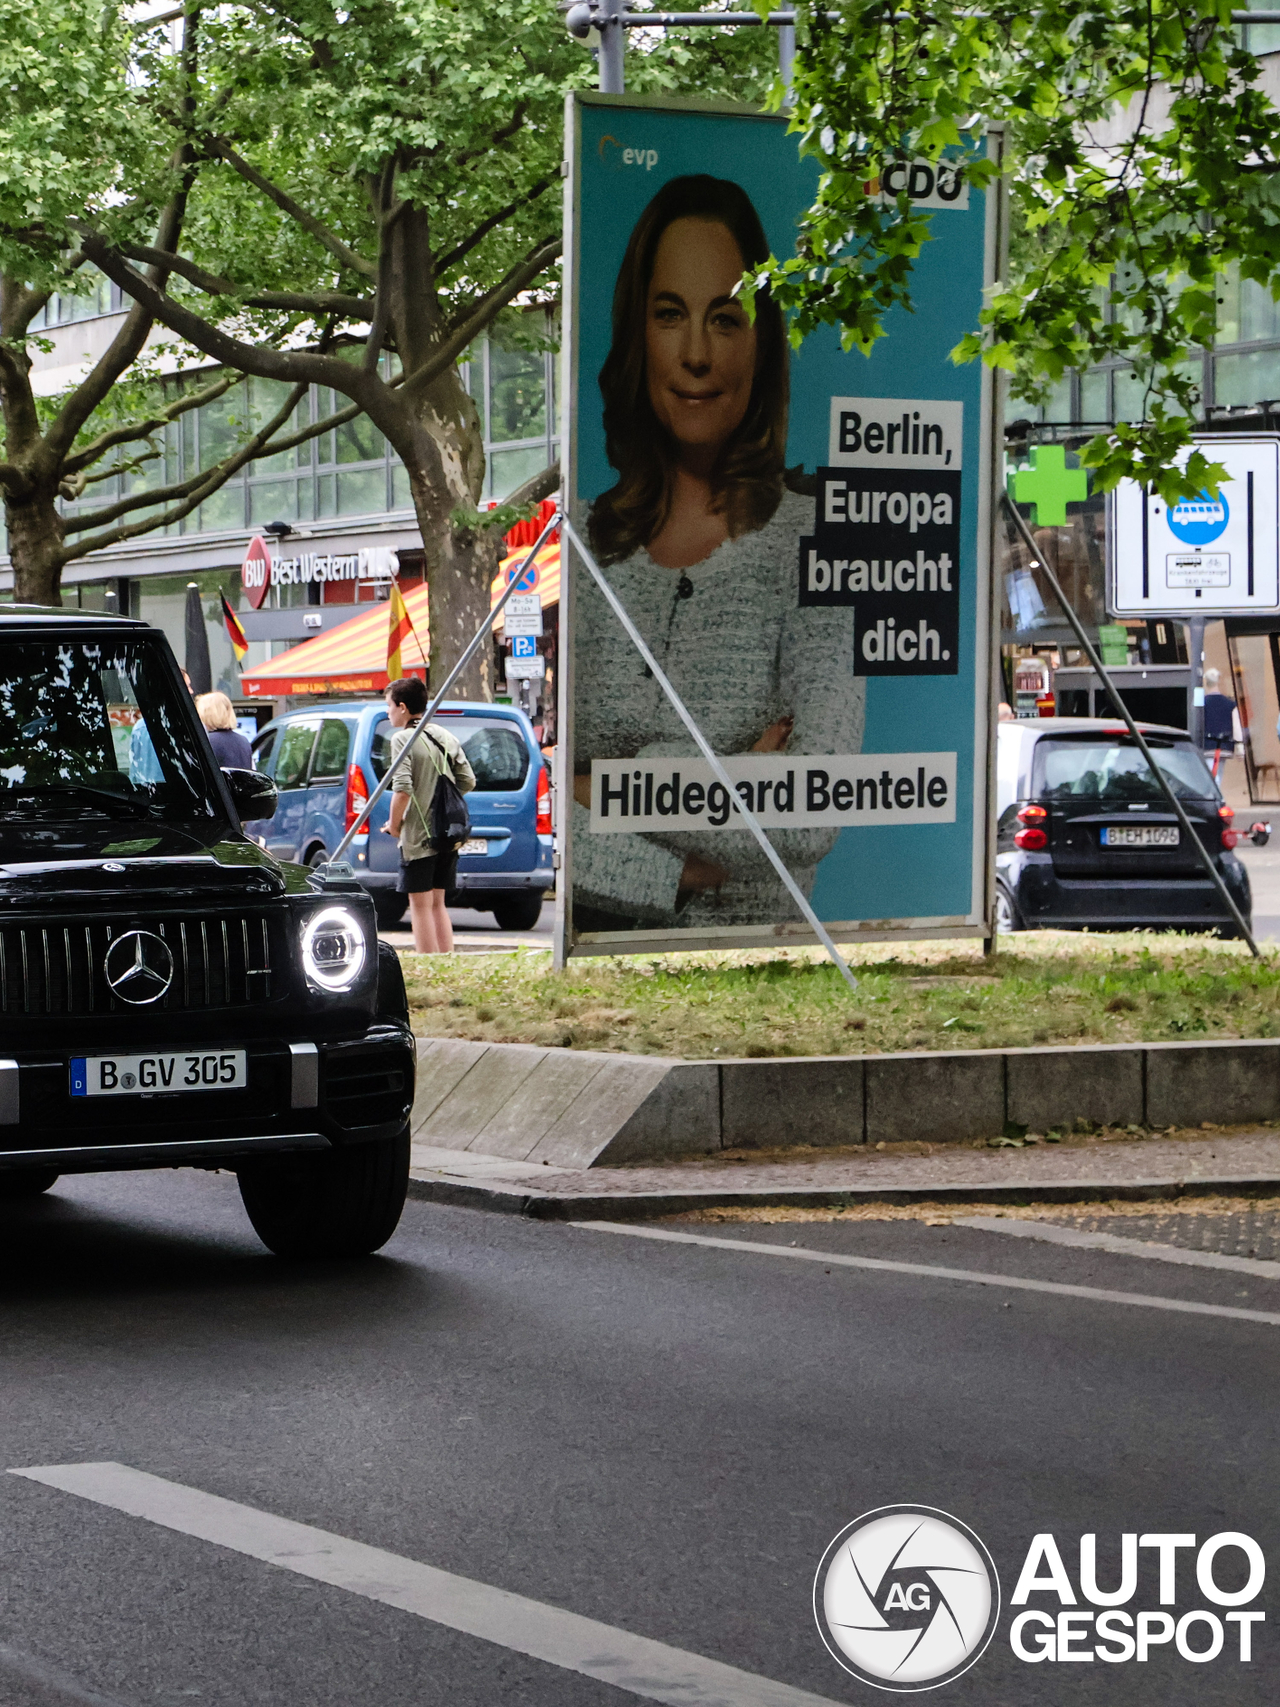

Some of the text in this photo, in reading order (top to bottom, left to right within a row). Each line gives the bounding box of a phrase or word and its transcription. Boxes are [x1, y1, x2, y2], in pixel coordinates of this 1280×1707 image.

[622, 145, 659, 172] evp
[883, 162, 962, 202] CDU
[838, 410, 953, 466] Berlin,
[824, 480, 953, 533] Europa
[245, 559, 265, 588] BW
[270, 555, 300, 586] Best
[300, 552, 358, 583] Western
[807, 549, 953, 592] braucht
[861, 617, 951, 662] dich.
[600, 767, 948, 826] Hildegard Bentele
[1109, 828, 1116, 844] B
[100, 1055, 236, 1090] B GV 305
